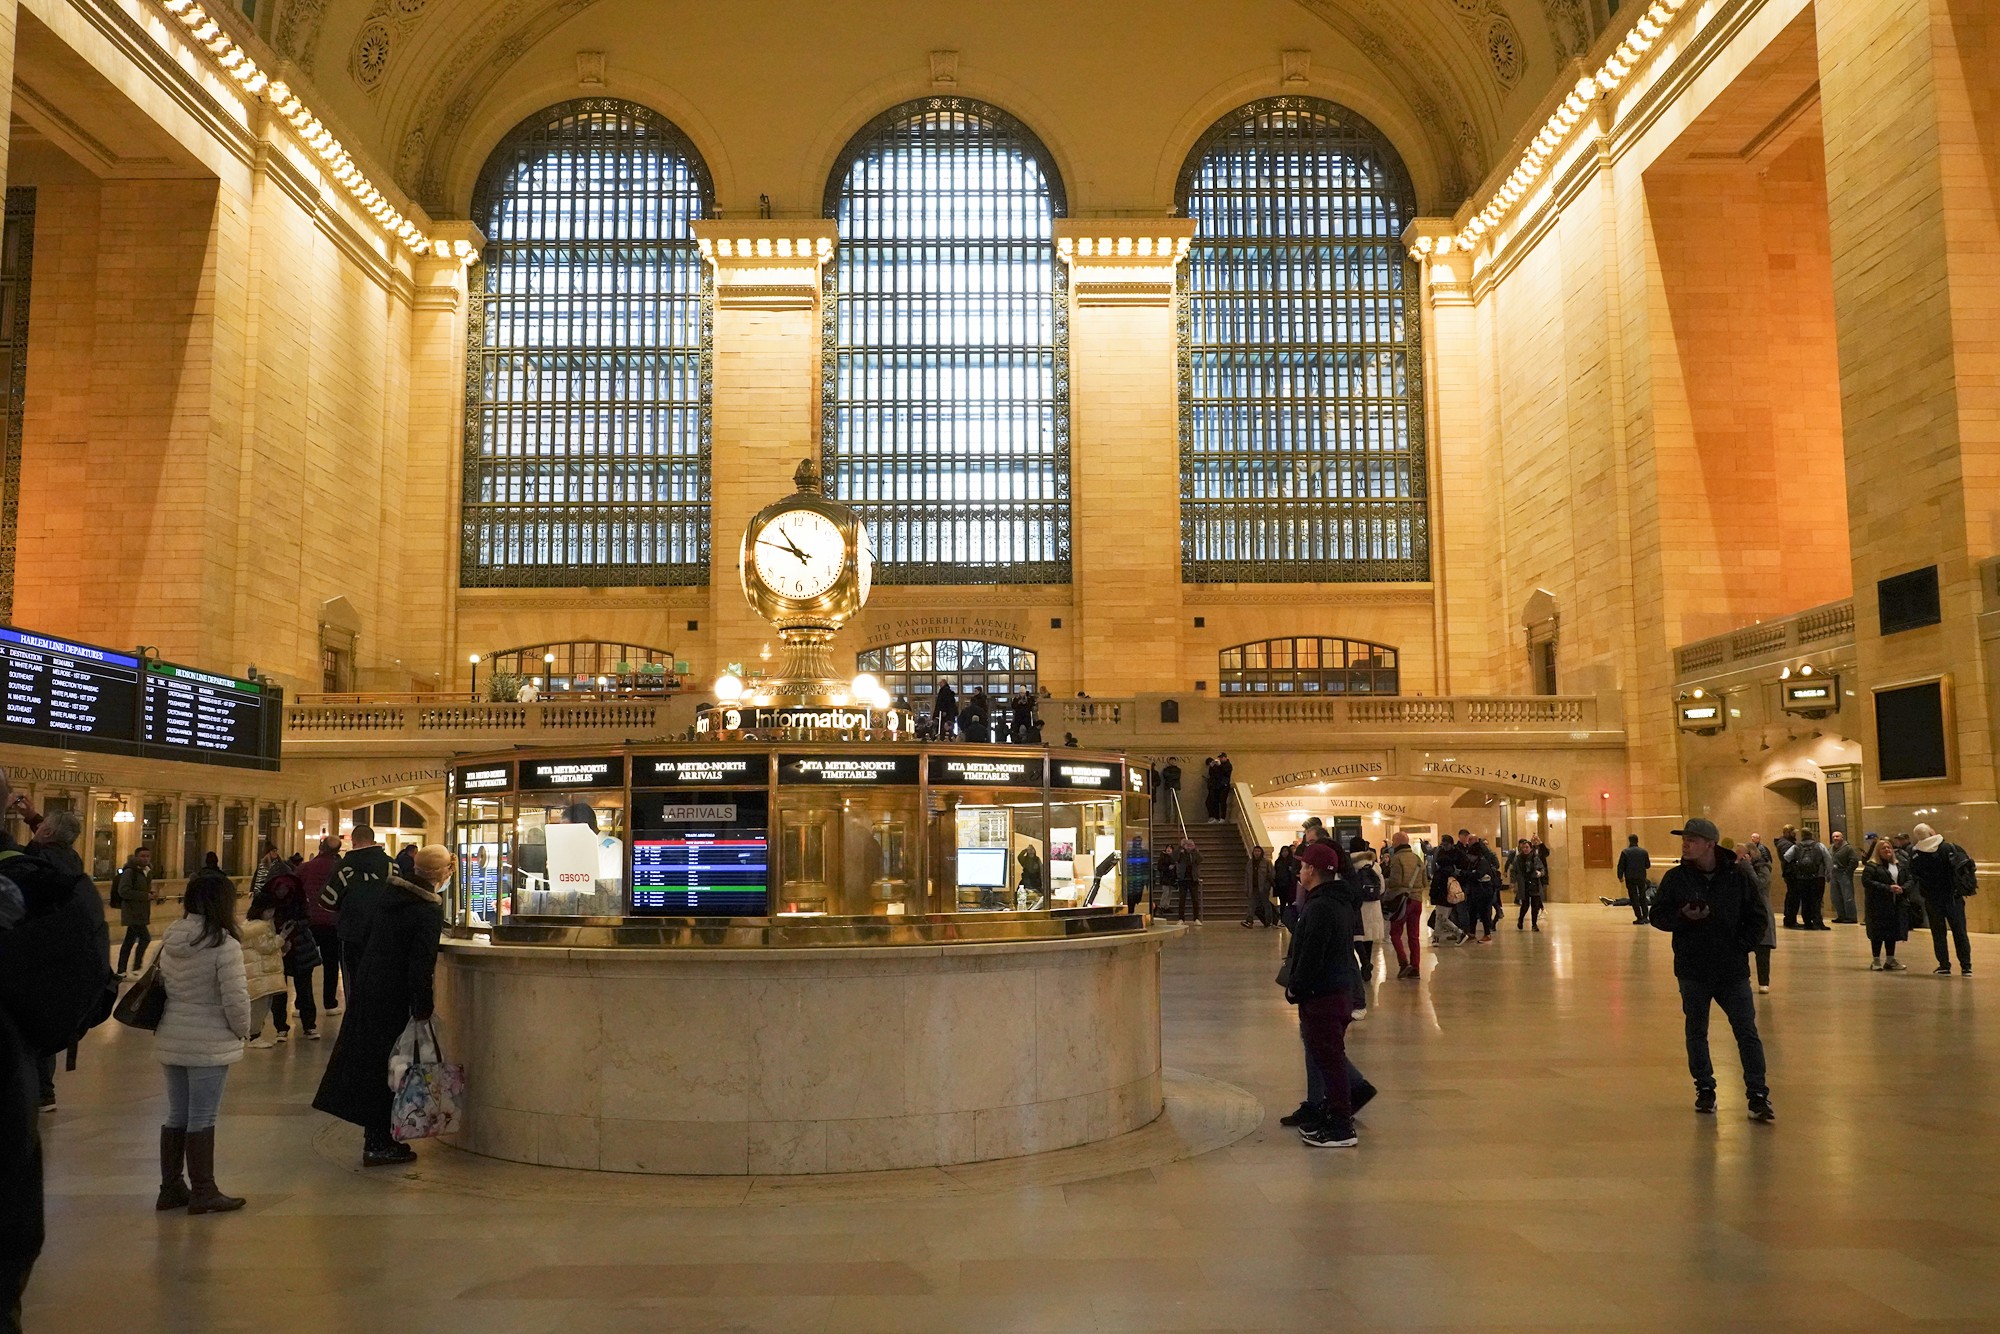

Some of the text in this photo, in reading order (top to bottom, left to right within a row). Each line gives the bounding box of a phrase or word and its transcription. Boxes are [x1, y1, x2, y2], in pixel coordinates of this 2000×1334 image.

[794, 516, 804, 526] 12
[780, 576, 786, 588] 7
[795, 579, 803, 592] 6
[875, 617, 1019, 632] TO VANDERBILT AVENUE
[867, 626, 1027, 644] THE CAMPBELL APARTMENT
[20, 634, 104, 660] HARLEM LINE DEPARTURES
[175, 668, 236, 688] HUDSON LINE DEPARTURES
[756, 708, 866, 729] Information
[536, 764, 608, 775] MTA METRO-NORTH
[655, 761, 746, 771] MTA METRO-NORTH
[802, 761, 896, 770] MTA METRO-NORTH
[947, 762, 1025, 772] MTA METRO-NORTH
[1424, 762, 1472, 774] TRACKS
[1474, 767, 1485, 776] 31
[1495, 769, 1509, 780] 42
[3, 765, 105, 784] TRO-NORTH TICKETS
[550, 773, 593, 783] TIMETABLES
[678, 771, 723, 780] ARRIVALS
[821, 770, 877, 779] TIMETABLES
[963, 772, 1010, 781] TIMETABLES
[1273, 762, 1382, 785] TICKET MACHINES
[329, 776, 378, 795] TICKET
[382, 769, 447, 785] MACHINES
[1520, 773, 1546, 788] LIRR
[1263, 799, 1304, 809] PASSAGE
[1330, 799, 1406, 813] WAITING ROOM
[668, 807, 733, 819] ARRIVALS
[559, 873, 590, 882] CLOSED
